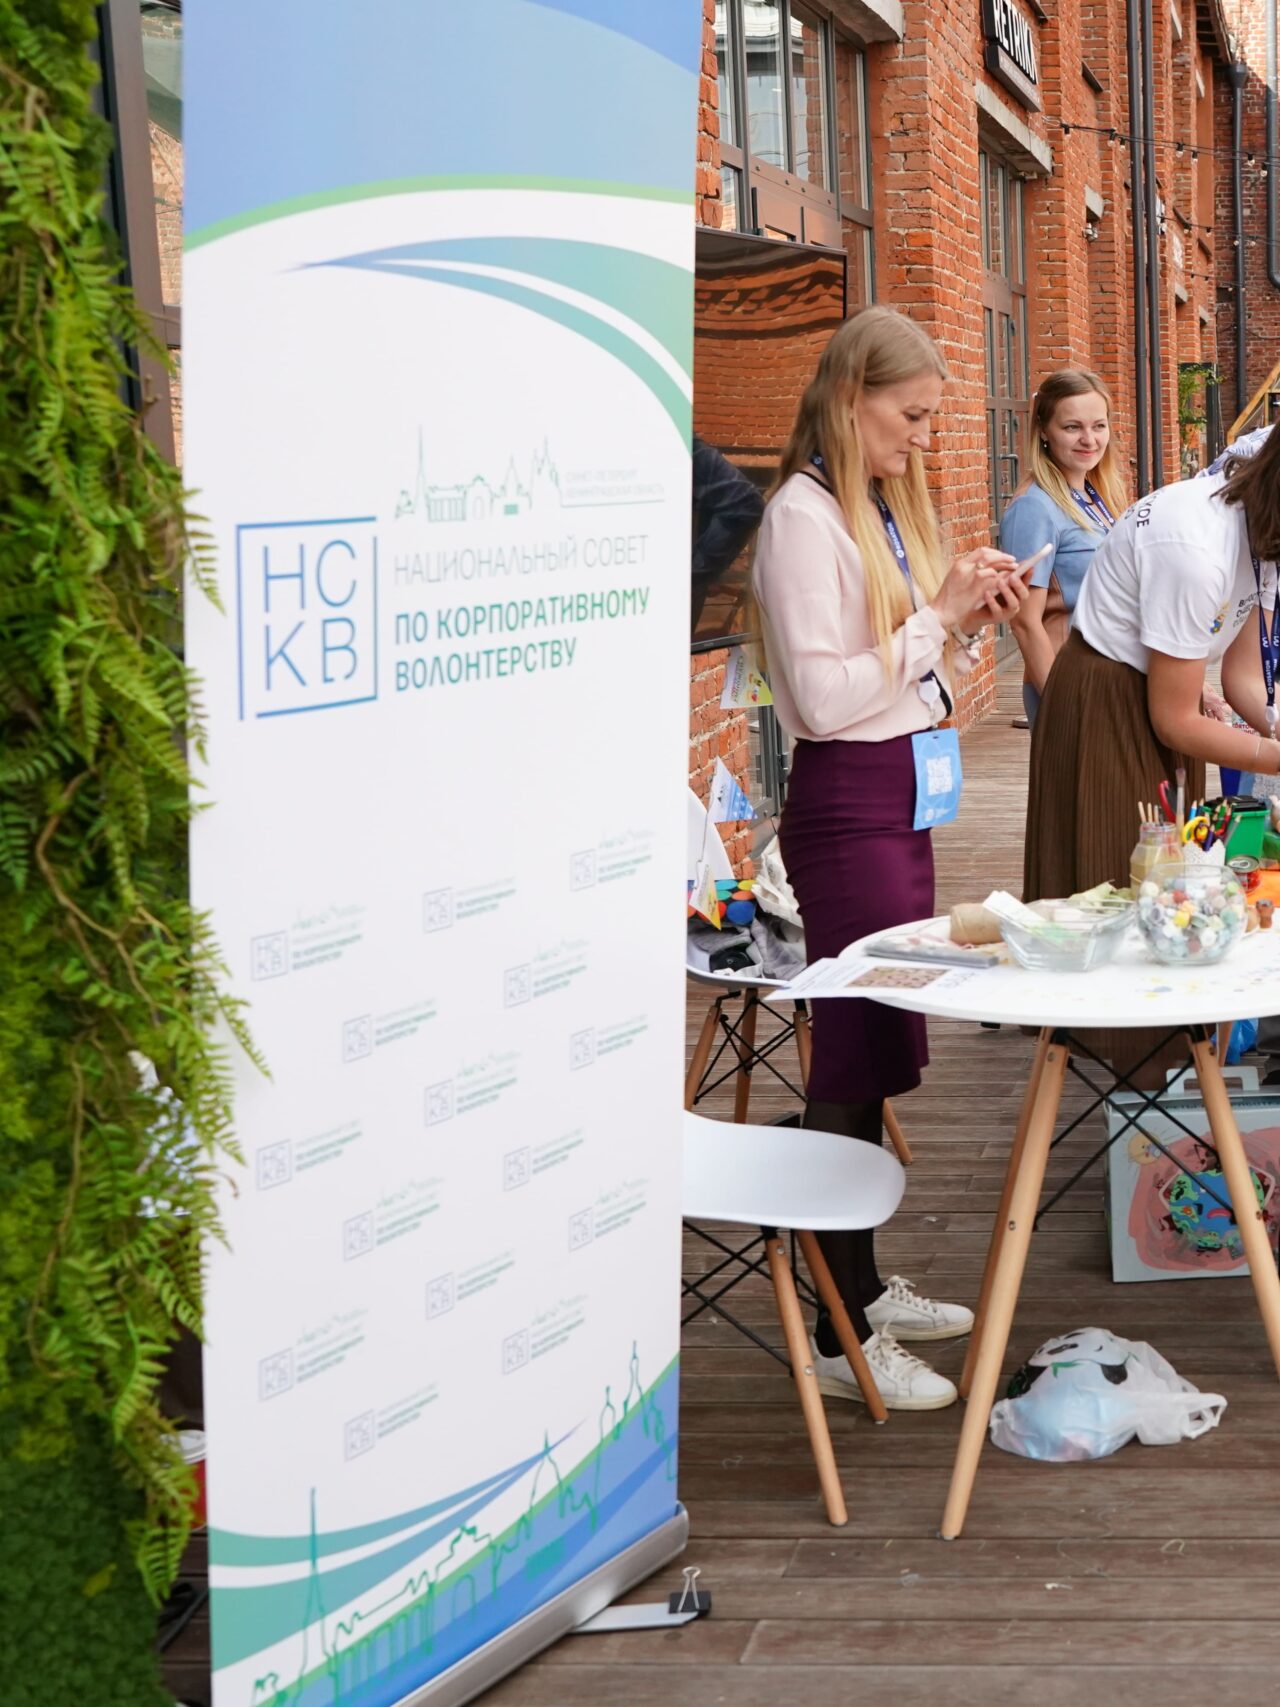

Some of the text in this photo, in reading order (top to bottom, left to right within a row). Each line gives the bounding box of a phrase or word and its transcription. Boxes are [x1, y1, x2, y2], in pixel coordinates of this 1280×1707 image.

[263, 539, 356, 613] НС
[394, 535, 650, 586] НАЦИОНАЛЬНЫЙ СОВЕТ
[395, 586, 651, 645] ПО КОРПОРАТИВНОМУ
[264, 617, 358, 691] КВ
[395, 636, 577, 692] ВОЛОНТЕРСТВУ
